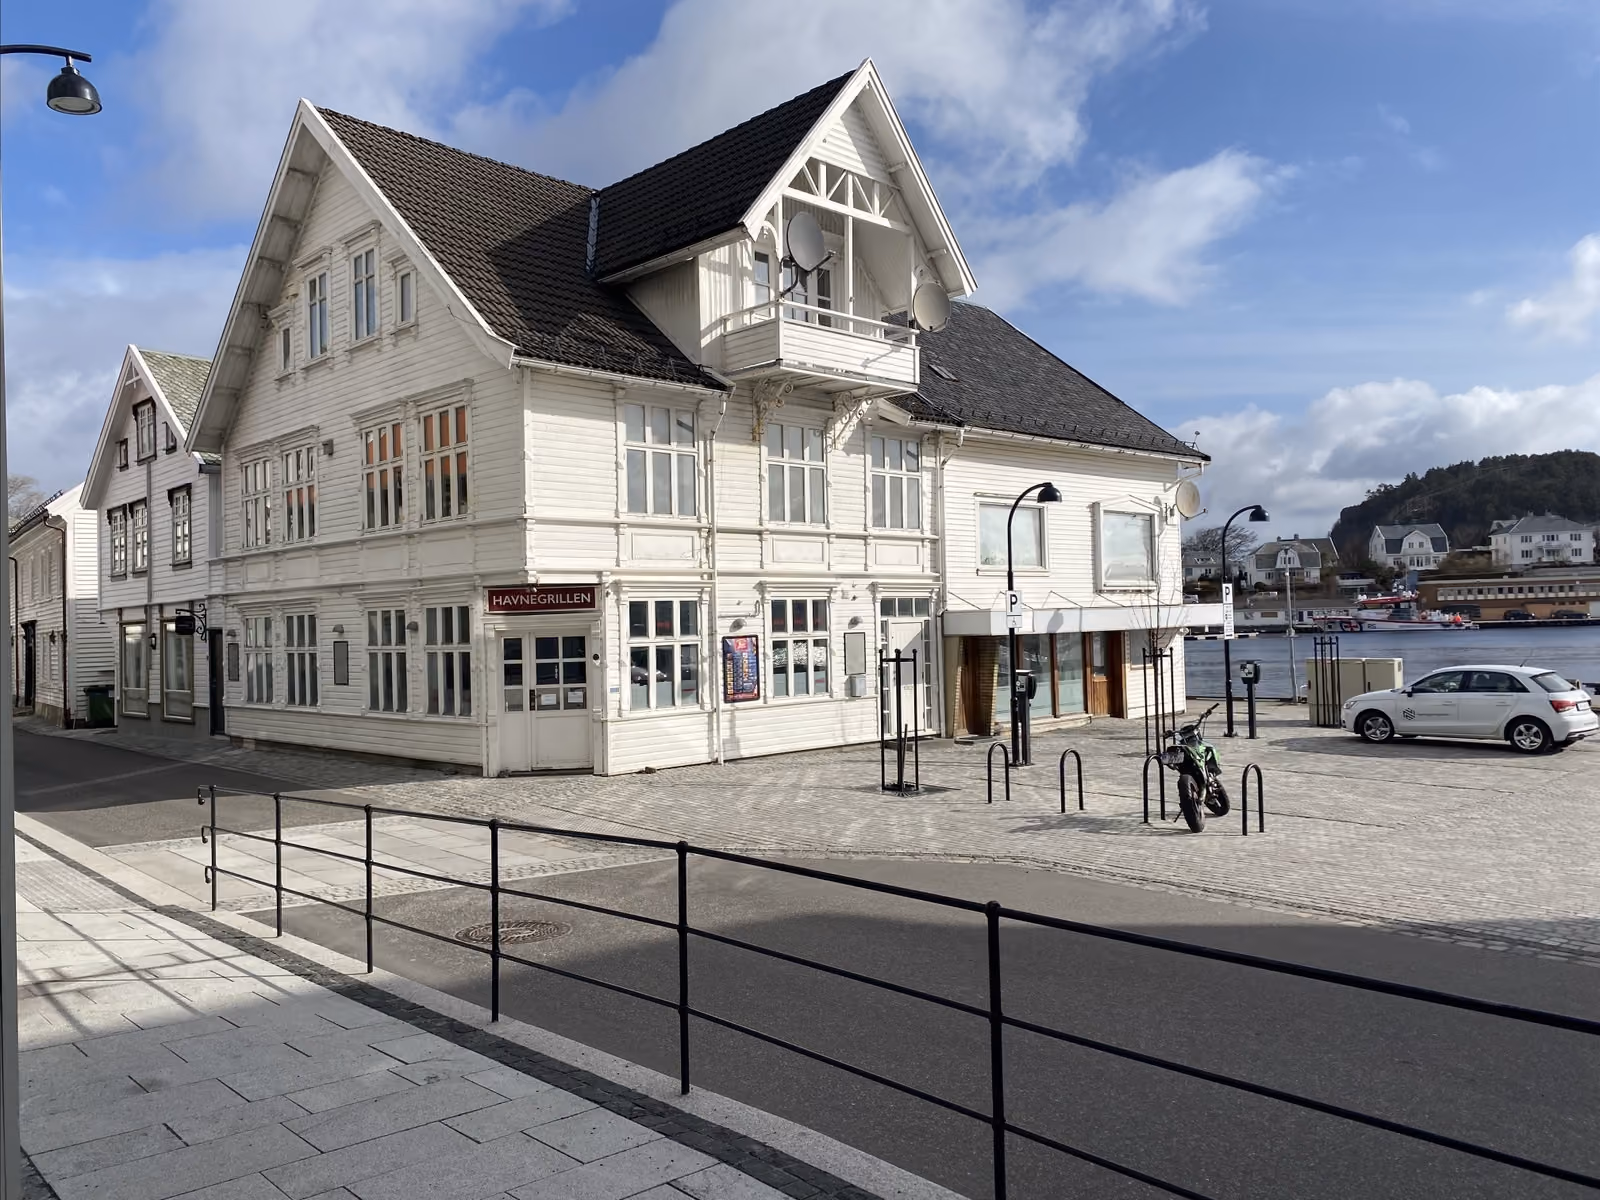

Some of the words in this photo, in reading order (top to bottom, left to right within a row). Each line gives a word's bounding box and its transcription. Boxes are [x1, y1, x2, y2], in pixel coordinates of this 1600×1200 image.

[493, 592, 591, 606] HAVNEGRILLEN
[1225, 586, 1230, 602] P
[1010, 594, 1018, 612] P
